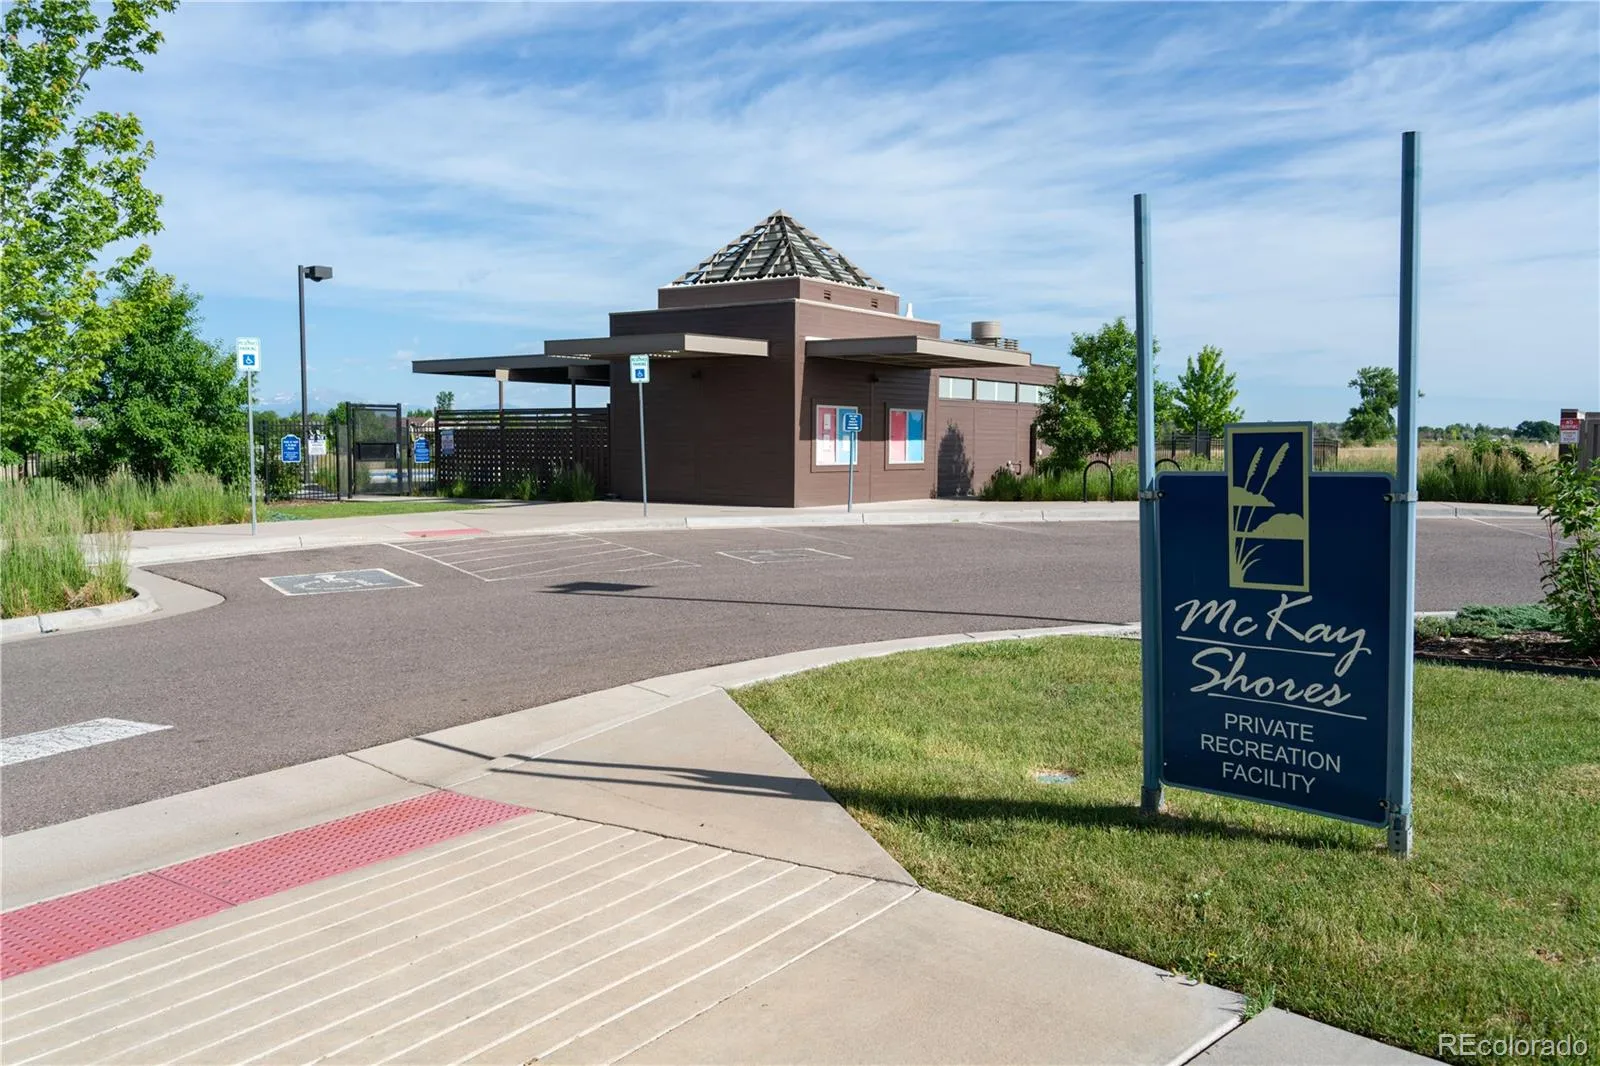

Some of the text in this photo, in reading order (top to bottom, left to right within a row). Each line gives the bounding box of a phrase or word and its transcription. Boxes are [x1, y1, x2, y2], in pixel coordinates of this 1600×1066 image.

[1190, 646, 1352, 708] Shores
[1224, 712, 1315, 743] PRIVATE
[1200, 733, 1341, 774] RECREATION
[1221, 761, 1316, 794] FACILITY
